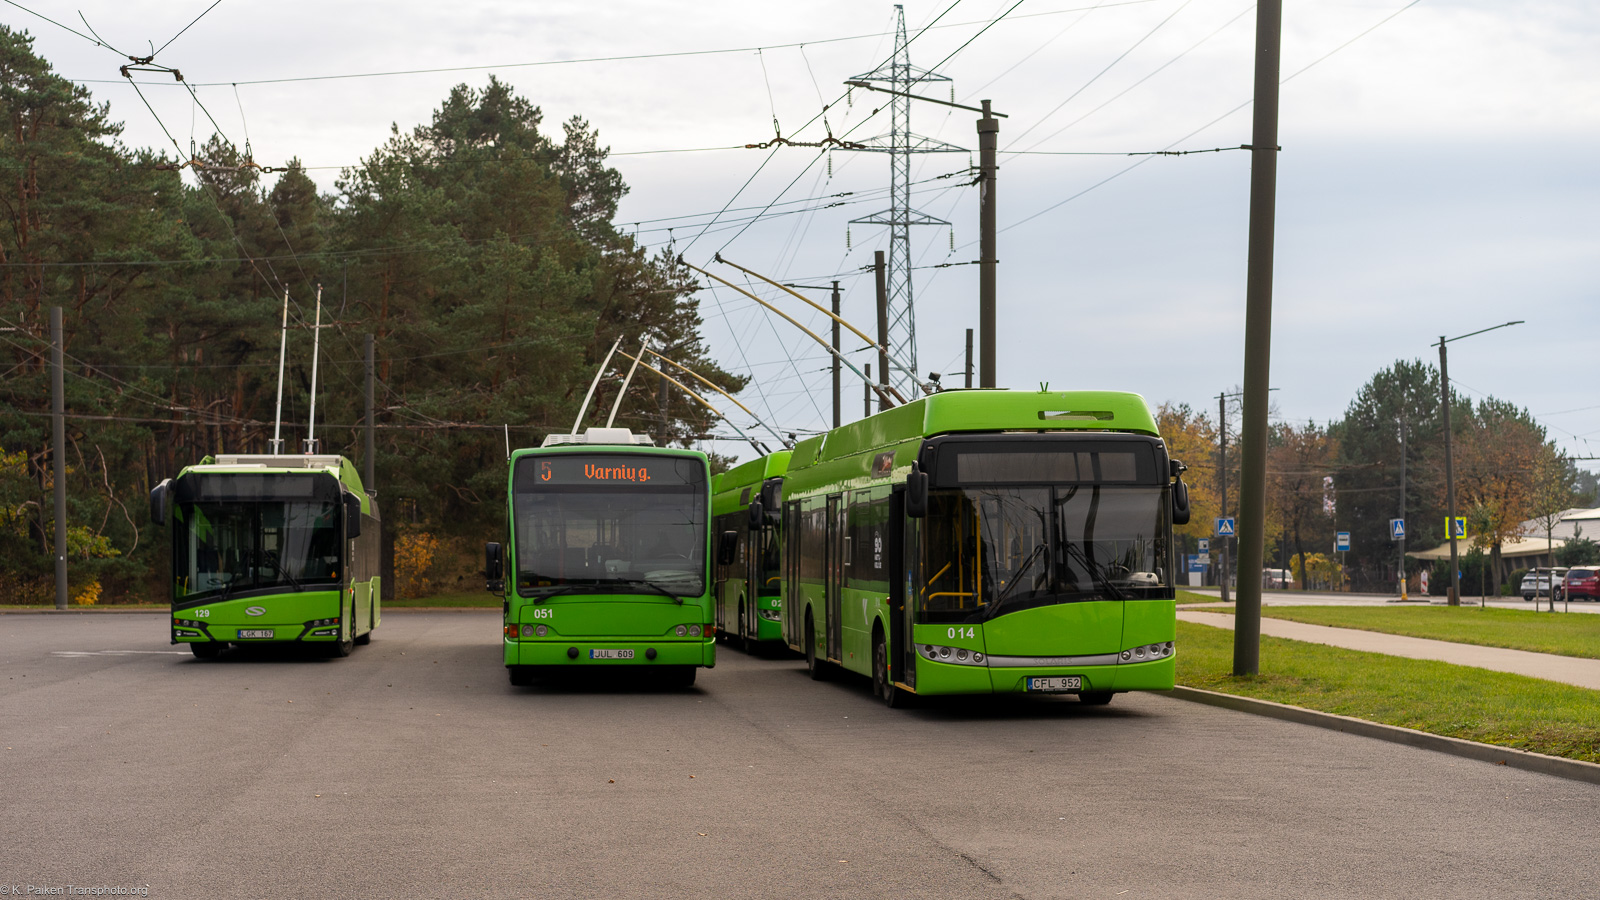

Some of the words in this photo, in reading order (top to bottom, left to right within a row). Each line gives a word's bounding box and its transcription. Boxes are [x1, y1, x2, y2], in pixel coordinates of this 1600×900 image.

[541, 461, 552, 482] 5
[584, 463, 635, 482] Varnių
[638, 466, 651, 482] g.
[195, 609, 210, 618] 129
[534, 608, 553, 619] 051
[947, 627, 975, 639] 014
[594, 650, 612, 658] JUL
[617, 650, 633, 658] 609
[1033, 657, 1073, 665] SOLARIS
[1033, 679, 1055, 688] CFL
[1061, 678, 1080, 688] 952
